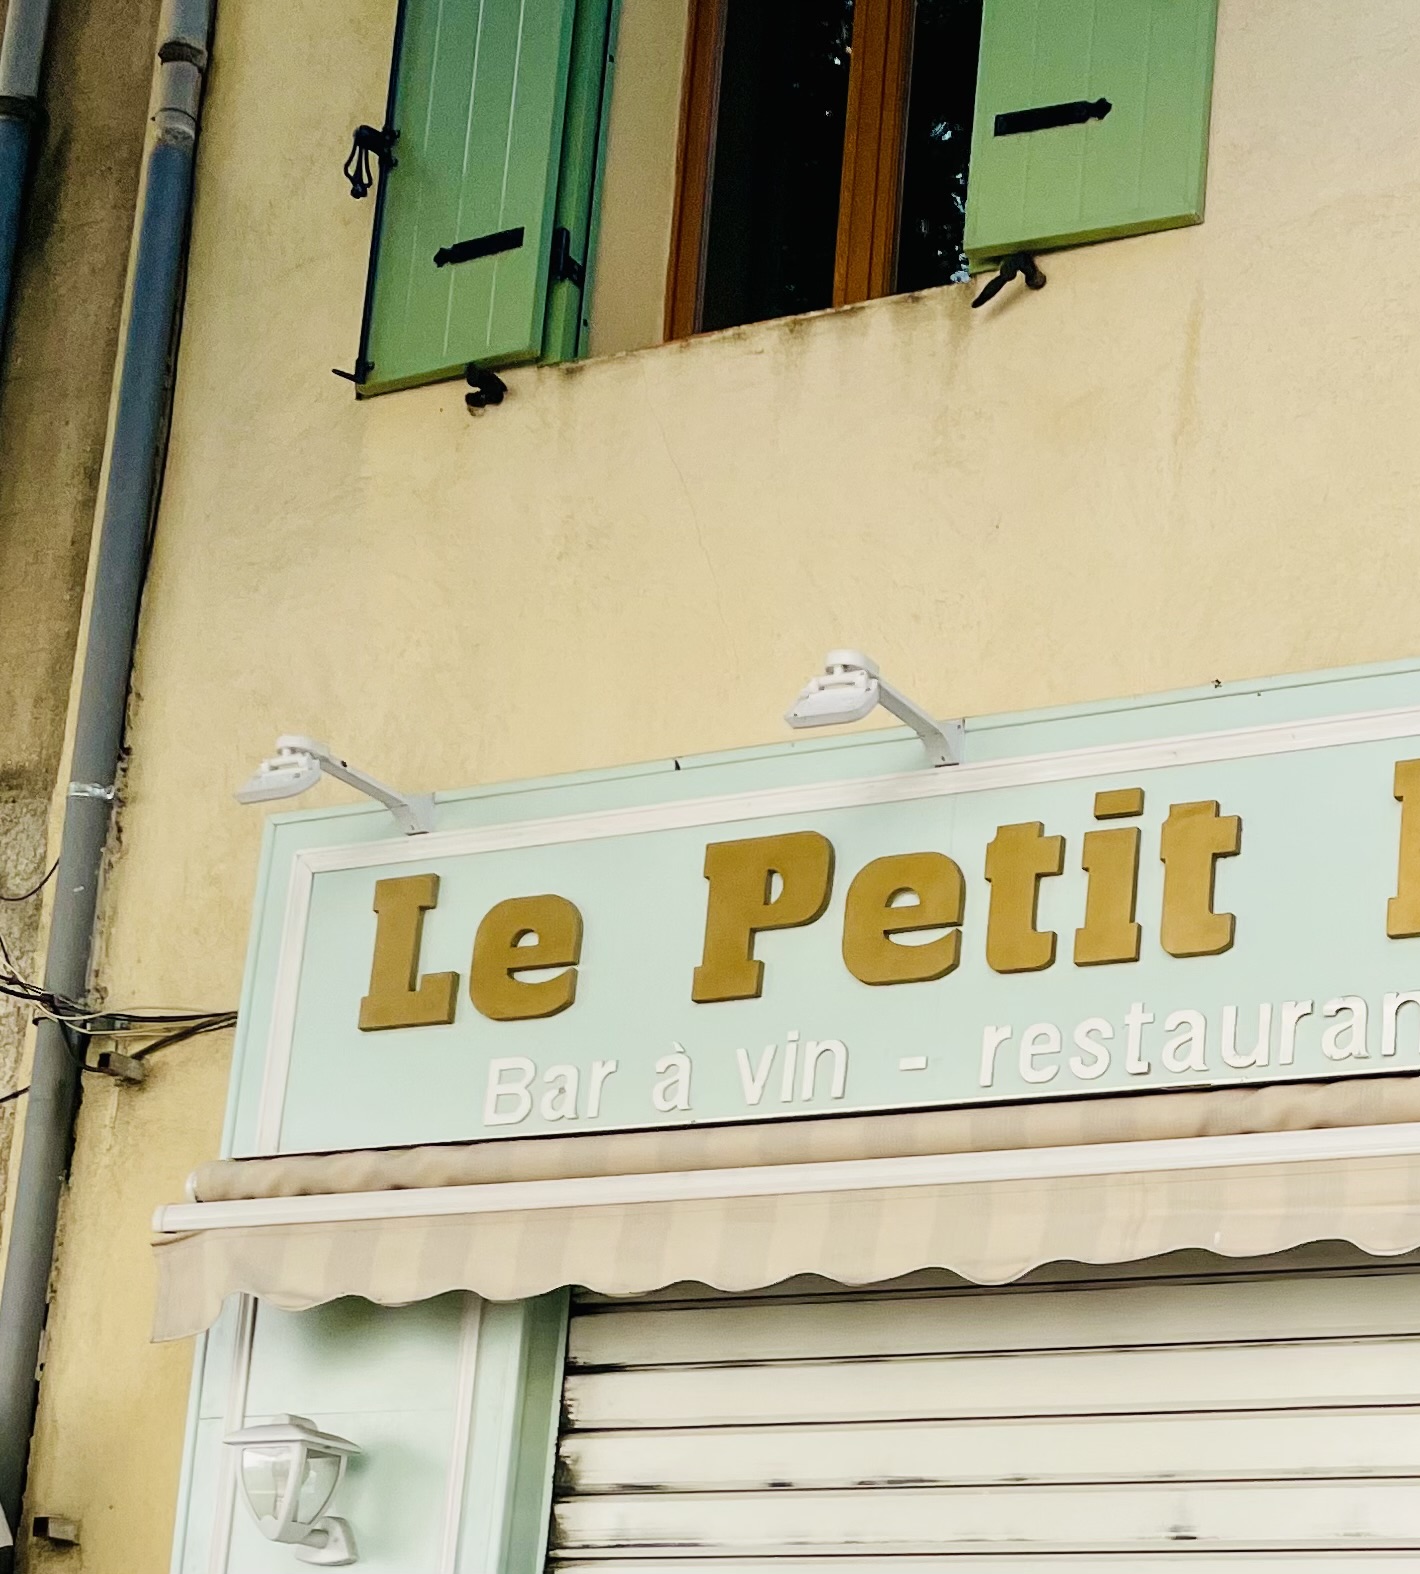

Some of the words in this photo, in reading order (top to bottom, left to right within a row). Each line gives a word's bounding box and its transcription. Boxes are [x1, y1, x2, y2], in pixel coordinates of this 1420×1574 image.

[359, 874, 583, 1032] Le
[692, 787, 1243, 1004] Petit
[483, 1055, 617, 1126] Bar
[653, 1041, 693, 1111] à
[736, 1030, 849, 1106] vin
[899, 1055, 928, 1072] -
